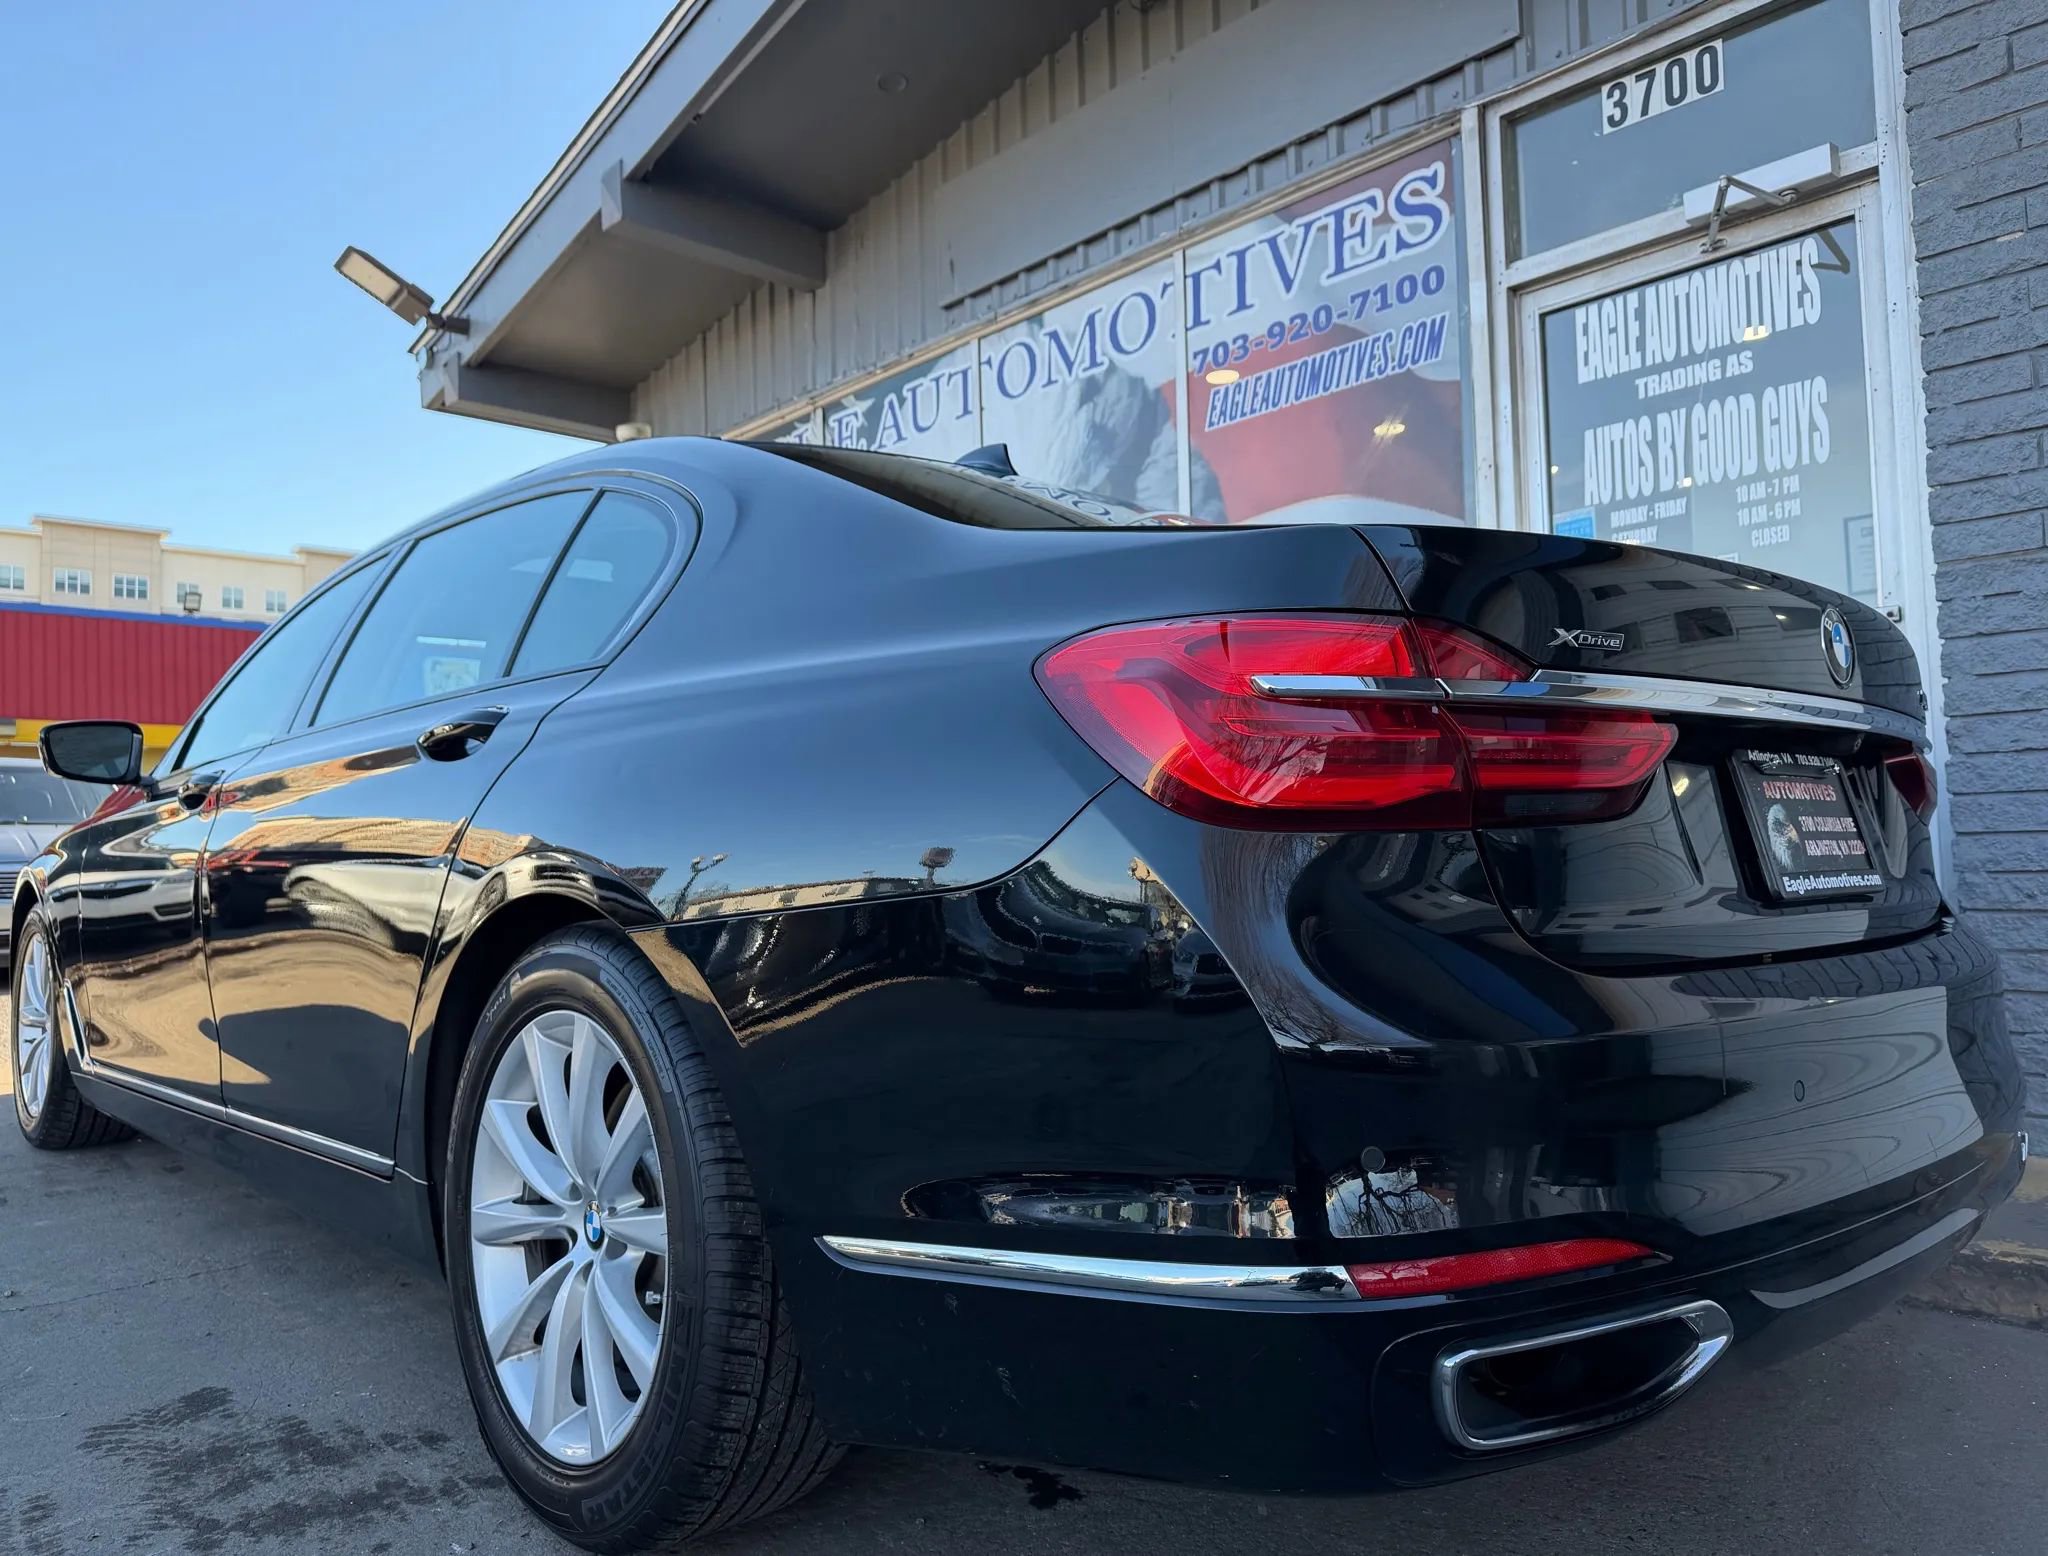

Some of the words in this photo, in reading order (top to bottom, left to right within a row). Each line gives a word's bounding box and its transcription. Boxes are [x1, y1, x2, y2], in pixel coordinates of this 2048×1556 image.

[1606, 45, 1720, 128] 3700
[872, 166, 1445, 450] AUTOMOTIVES
[1193, 264, 1445, 374] 703-920-7100
[1575, 292, 1641, 385] EAGLE
[1645, 237, 1822, 367] AUTOMOTIVES
[1206, 314, 1448, 429] EAGLEAUTOMOTIVES.COM
[1635, 359, 1722, 399] TRADING
[1726, 350, 1754, 376] AS
[1584, 415, 1654, 506] AUTOS
[1657, 407, 1687, 492] BY
[1691, 393, 1758, 487] GOOD
[1762, 376, 1831, 474] GUYS
[1611, 504, 1649, 529] MONDAY
[1655, 497, 1687, 520] FRIDAY
[1736, 484, 1748, 503] 10
[1749, 481, 1766, 501] AM
[1772, 478, 1779, 496] 7
[1783, 474, 1800, 495] PM
[1737, 507, 1750, 526] 10
[1751, 504, 1768, 524] AM
[1774, 501, 1783, 519] 6
[1784, 498, 1801, 518] PM
[1751, 524, 1790, 547] CLOSED
[1762, 780, 1837, 802] AUTOMOTIVES
[1782, 872, 1882, 895] EagleAutomotives.com
